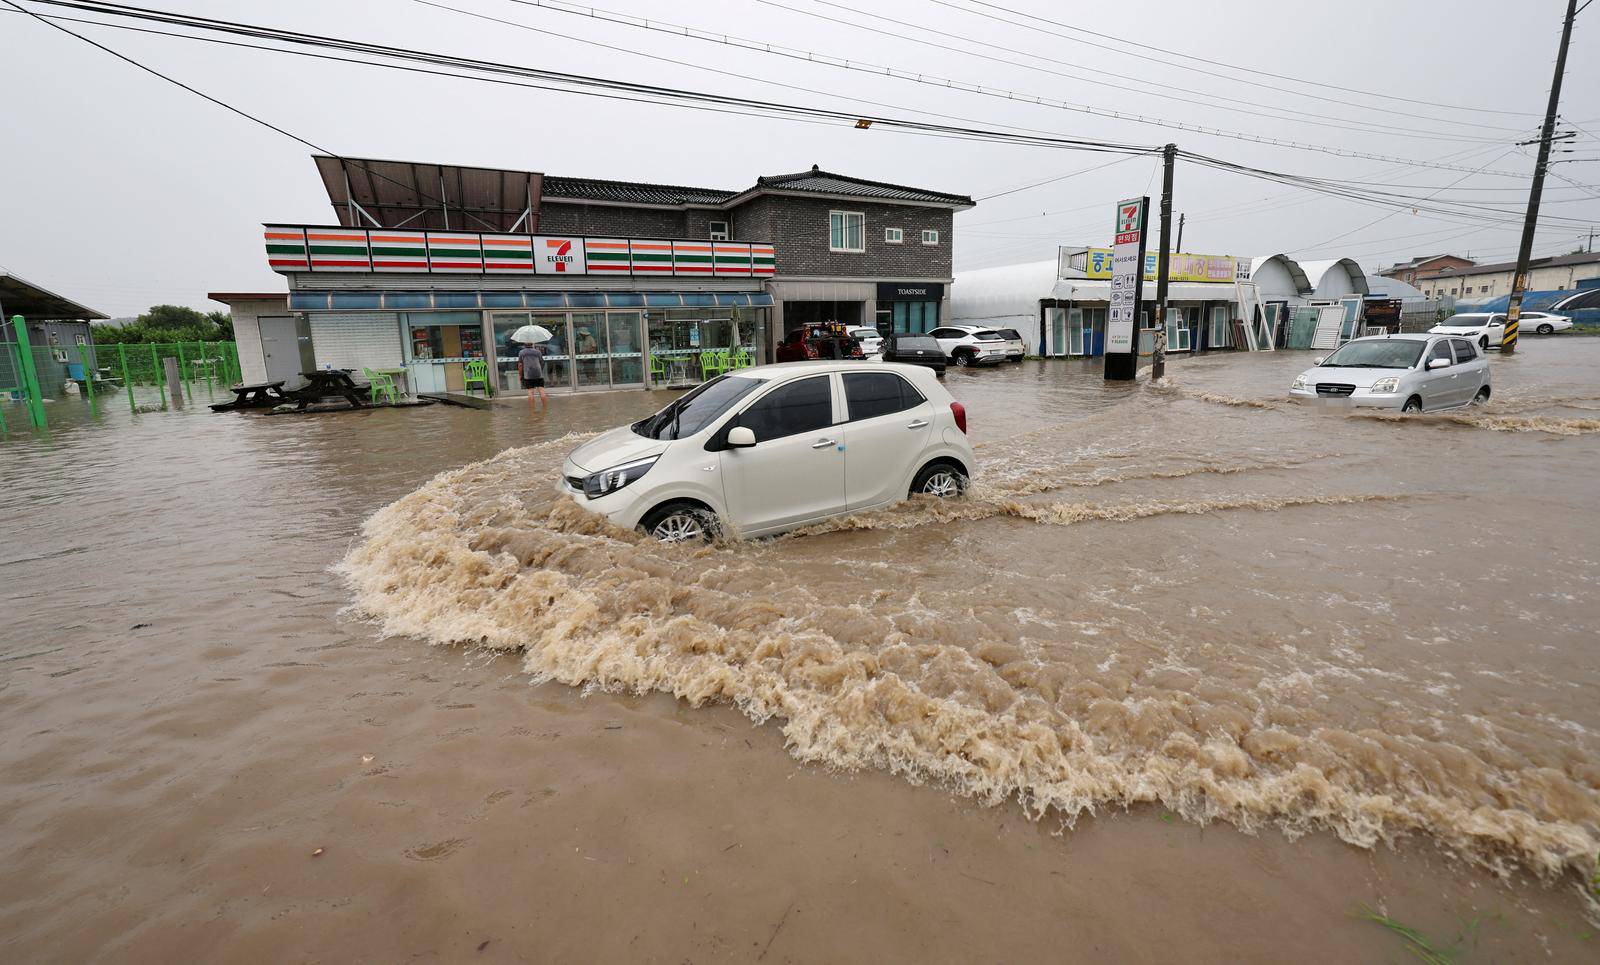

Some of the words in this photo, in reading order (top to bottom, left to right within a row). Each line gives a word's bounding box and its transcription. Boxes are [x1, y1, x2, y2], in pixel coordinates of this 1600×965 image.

[1123, 206, 1136, 230] 7
[1118, 233, 1137, 243] 편의점
[547, 240, 571, 272] 7
